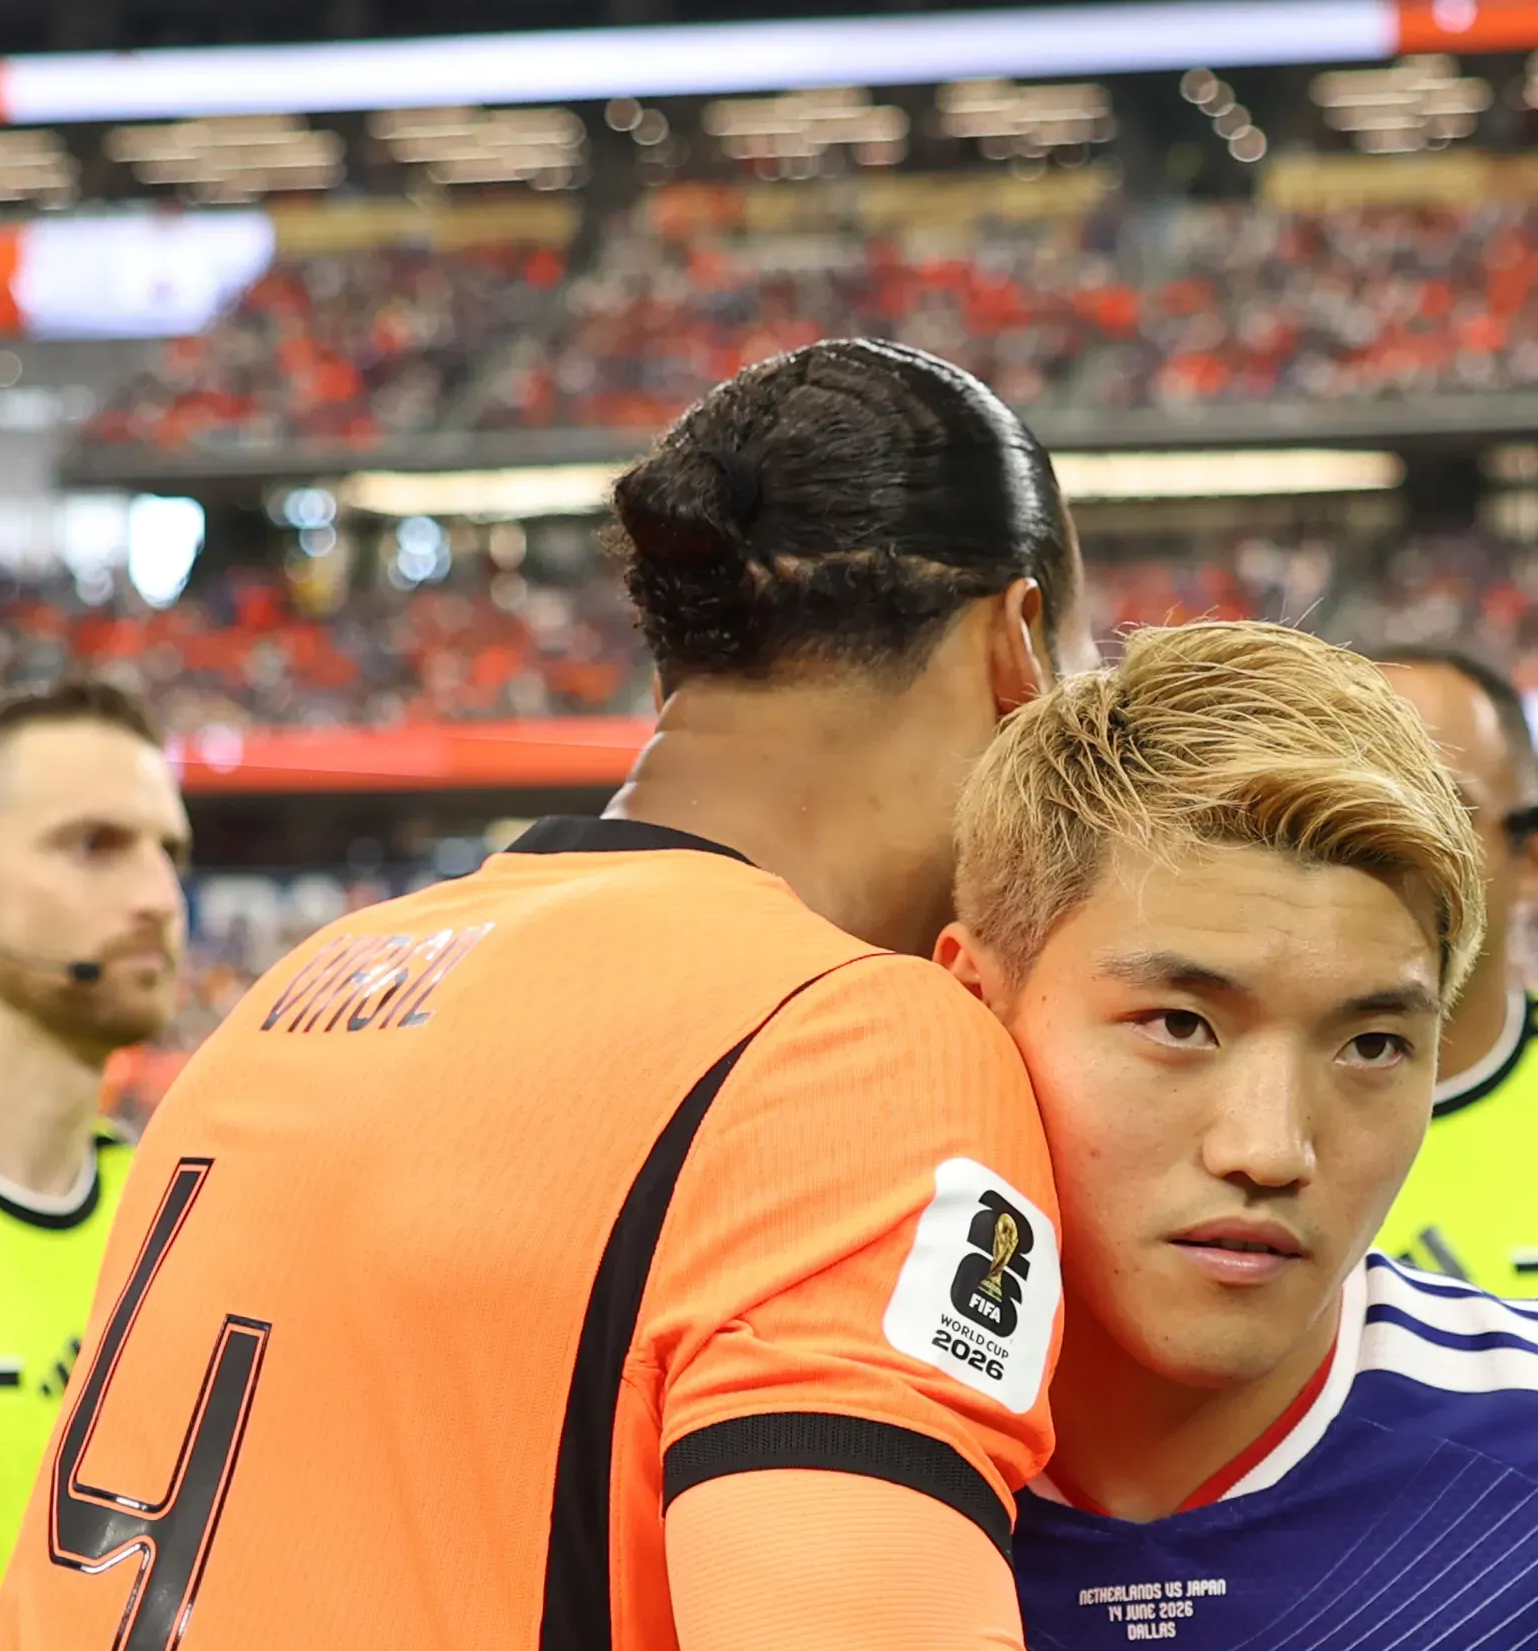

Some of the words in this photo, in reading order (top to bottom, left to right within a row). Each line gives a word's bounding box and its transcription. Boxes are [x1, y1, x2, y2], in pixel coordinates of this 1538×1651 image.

[258, 920, 497, 1034] VIRGIL
[969, 1293, 1002, 1324] FIFA
[940, 1313, 985, 1346] WORLD
[986, 1340, 1009, 1360] CUP
[931, 1329, 1004, 1381] 2026
[1079, 1582, 1162, 1606] NETHERLANDS
[1186, 1579, 1226, 1597] JAPAN
[1108, 1607, 1122, 1622] 14
[1124, 1603, 1156, 1620] JUNE
[1159, 1600, 1194, 1618] 2026
[1127, 1621, 1176, 1641] DALLAS
